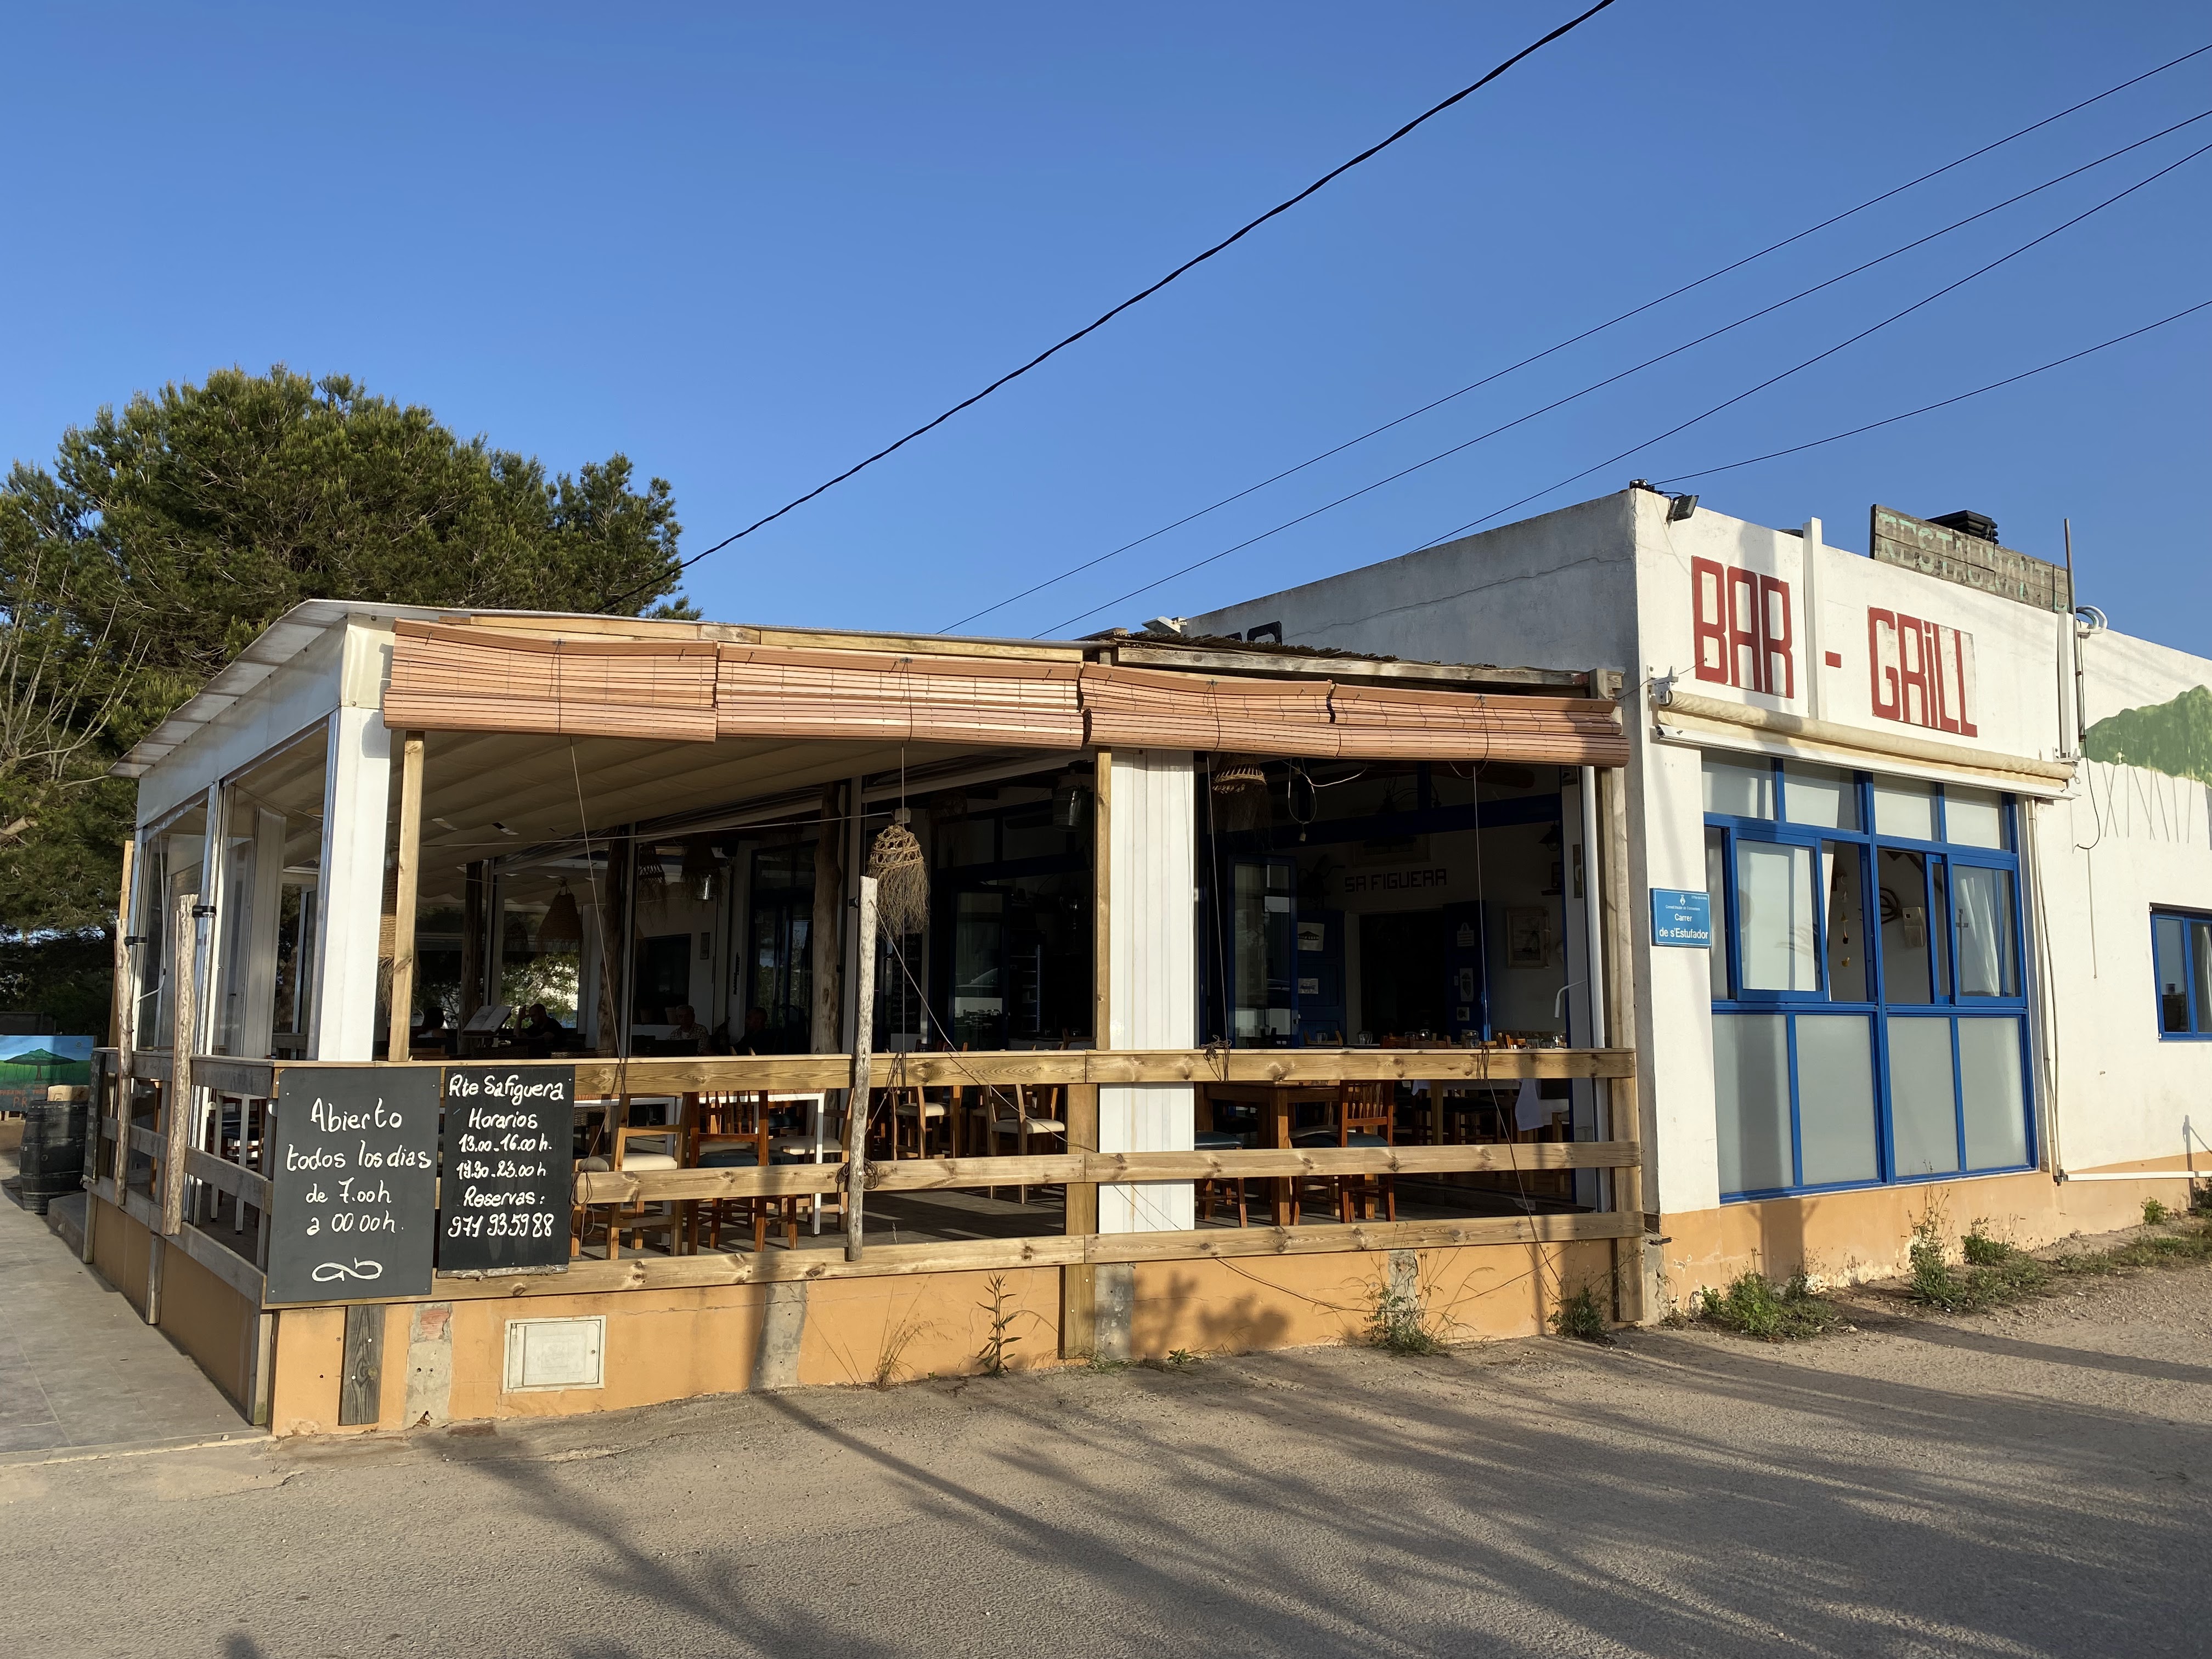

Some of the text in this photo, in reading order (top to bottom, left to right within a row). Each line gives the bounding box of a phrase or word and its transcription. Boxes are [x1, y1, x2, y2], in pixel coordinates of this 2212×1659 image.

[1692, 555, 1794, 699] BAR
[1345, 868, 1447, 893] SA FIGUERA
[1674, 913, 1692, 922] Carrer
[1659, 927, 1708, 939] de s'Estufador
[449, 1074, 479, 1097] Rte
[311, 1097, 403, 1133] Abierto
[469, 1107, 538, 1130] Horarios
[286, 1143, 346, 1171] todos
[306, 1183, 328, 1203] de
[306, 1217, 320, 1236] a
[448, 1215, 484, 1238] 971
